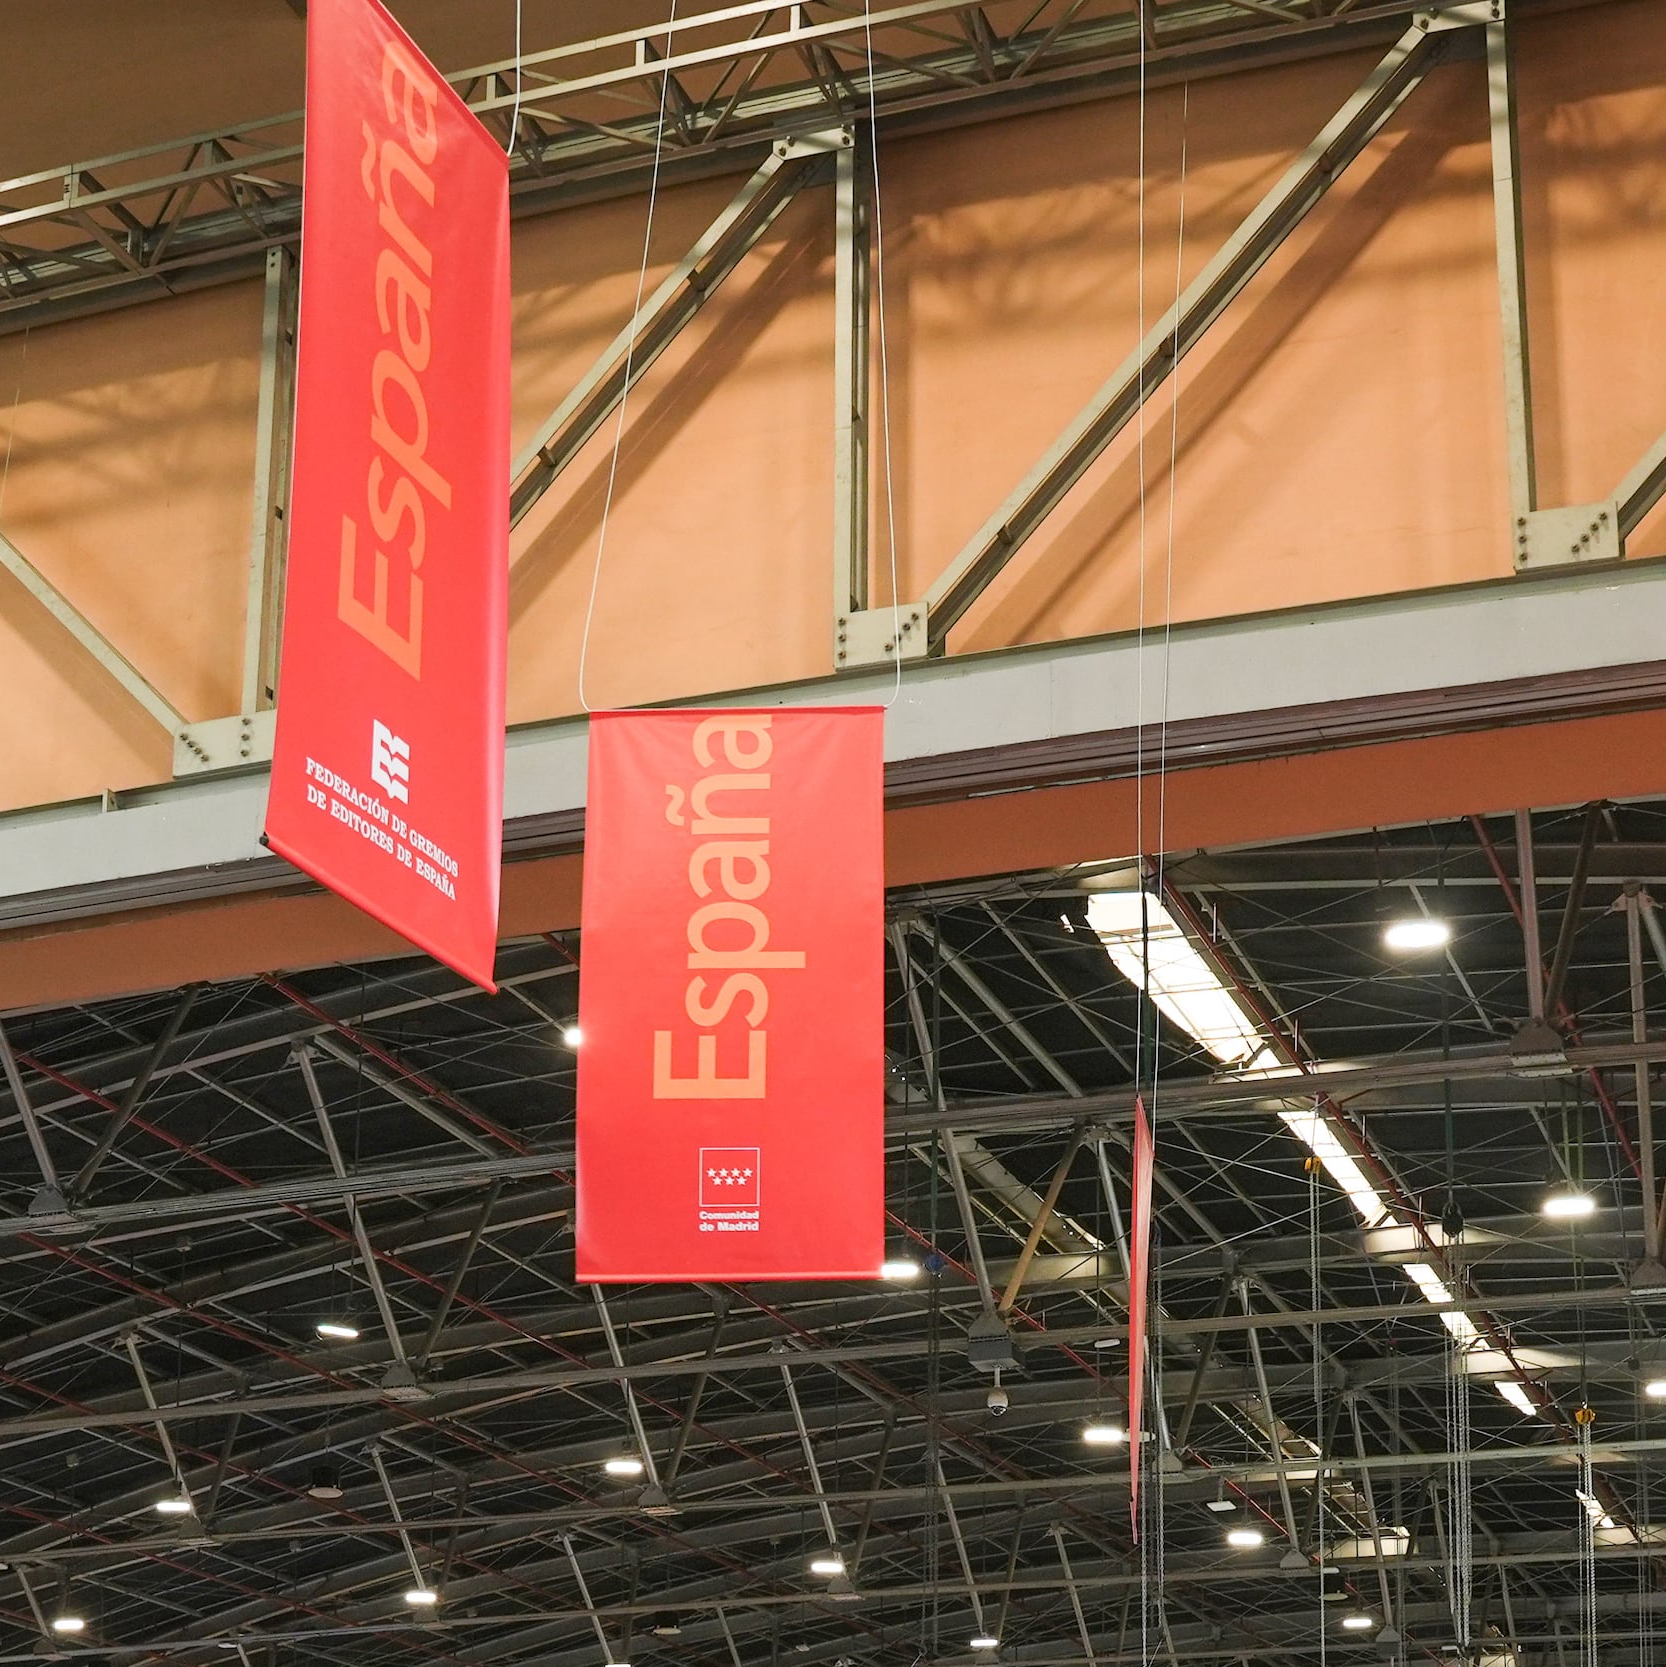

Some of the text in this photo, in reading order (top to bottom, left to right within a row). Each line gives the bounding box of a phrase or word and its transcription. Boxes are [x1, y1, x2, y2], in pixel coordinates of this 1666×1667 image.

[336, 40, 452, 683] España
[306, 756, 459, 878] FEDERACIÓN DE GREMIOS
[307, 784, 456, 901] DE EDITORES DE ESPAÑA
[654, 712, 805, 1101] España
[699, 1210, 760, 1220] Comunidad
[699, 1221, 760, 1231] de Madrid
